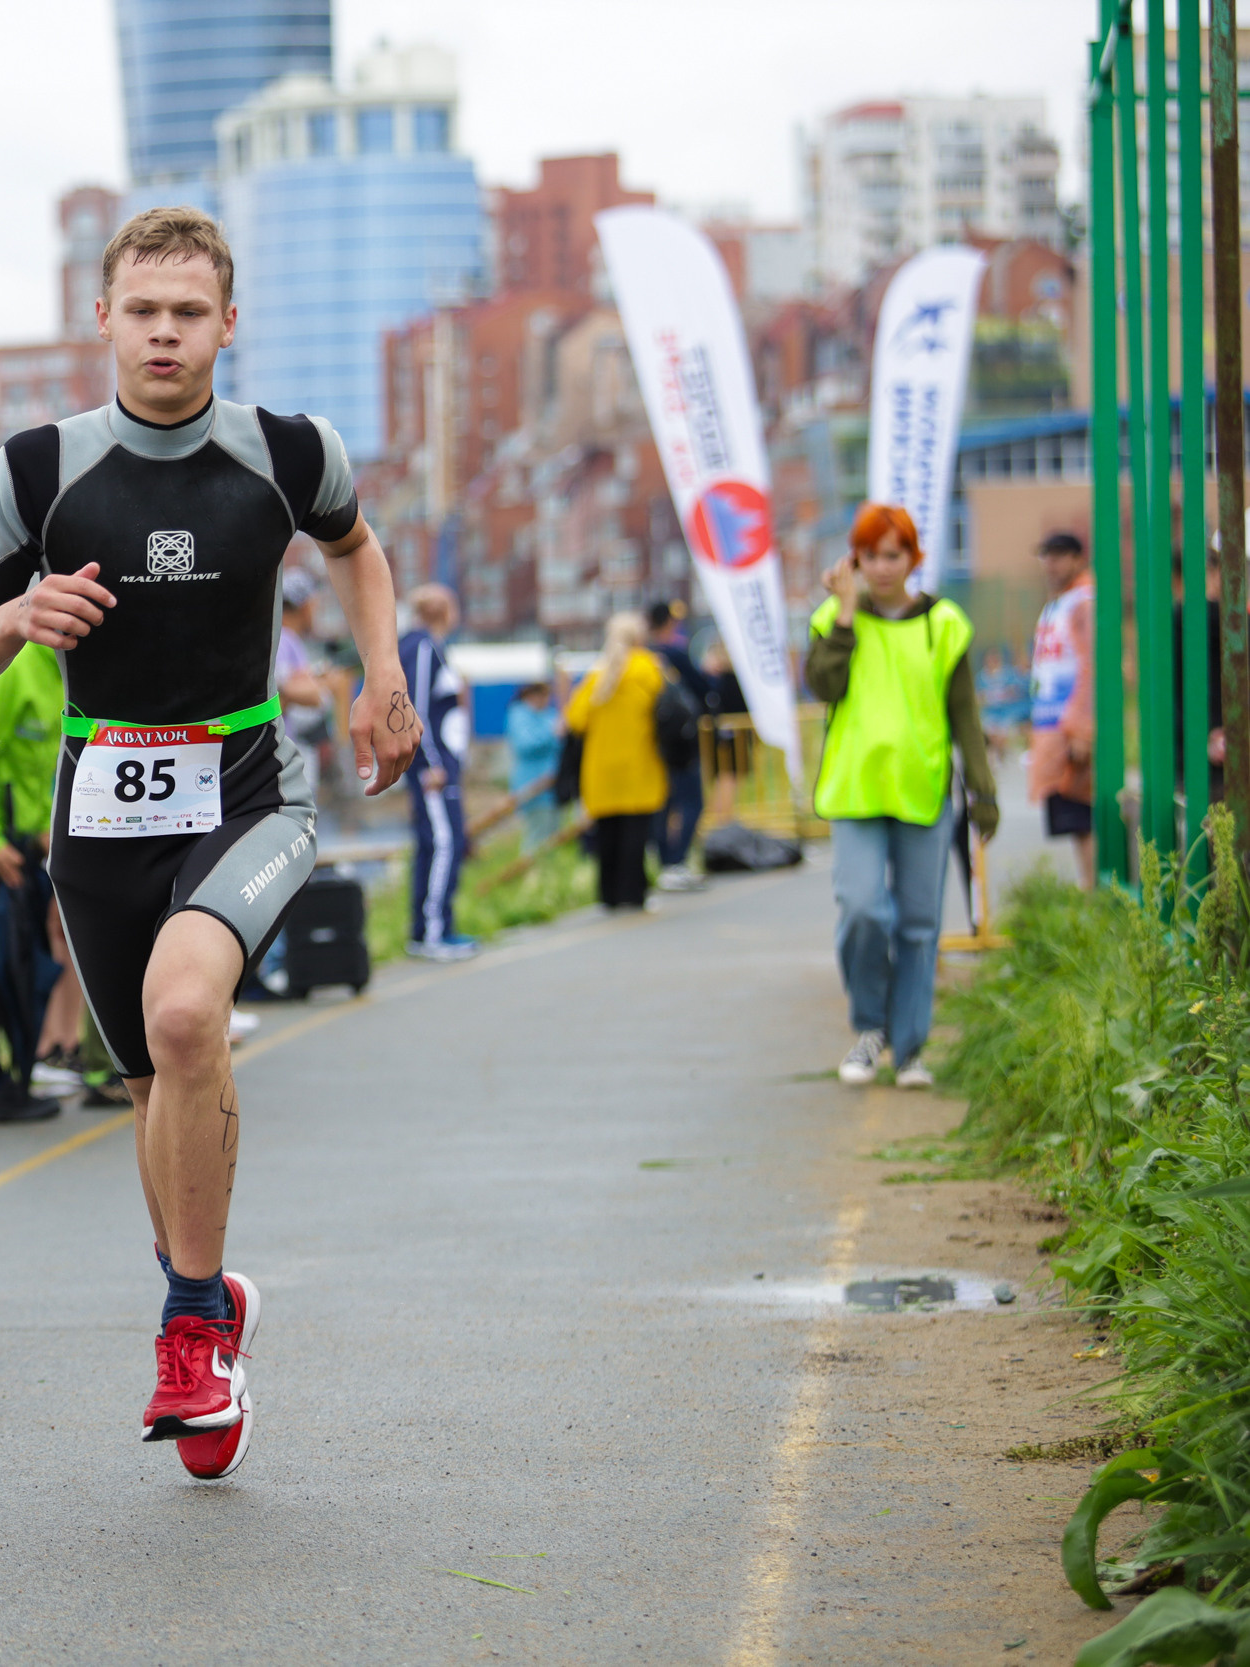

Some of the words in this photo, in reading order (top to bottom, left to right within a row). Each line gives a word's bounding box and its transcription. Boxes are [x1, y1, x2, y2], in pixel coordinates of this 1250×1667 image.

[119, 575, 163, 583] MAUI
[166, 571, 222, 582] WOWIE
[104, 730, 191, 747] АКВАТЛОН
[113, 758, 176, 803] 85
[239, 851, 290, 906] WOWIE
